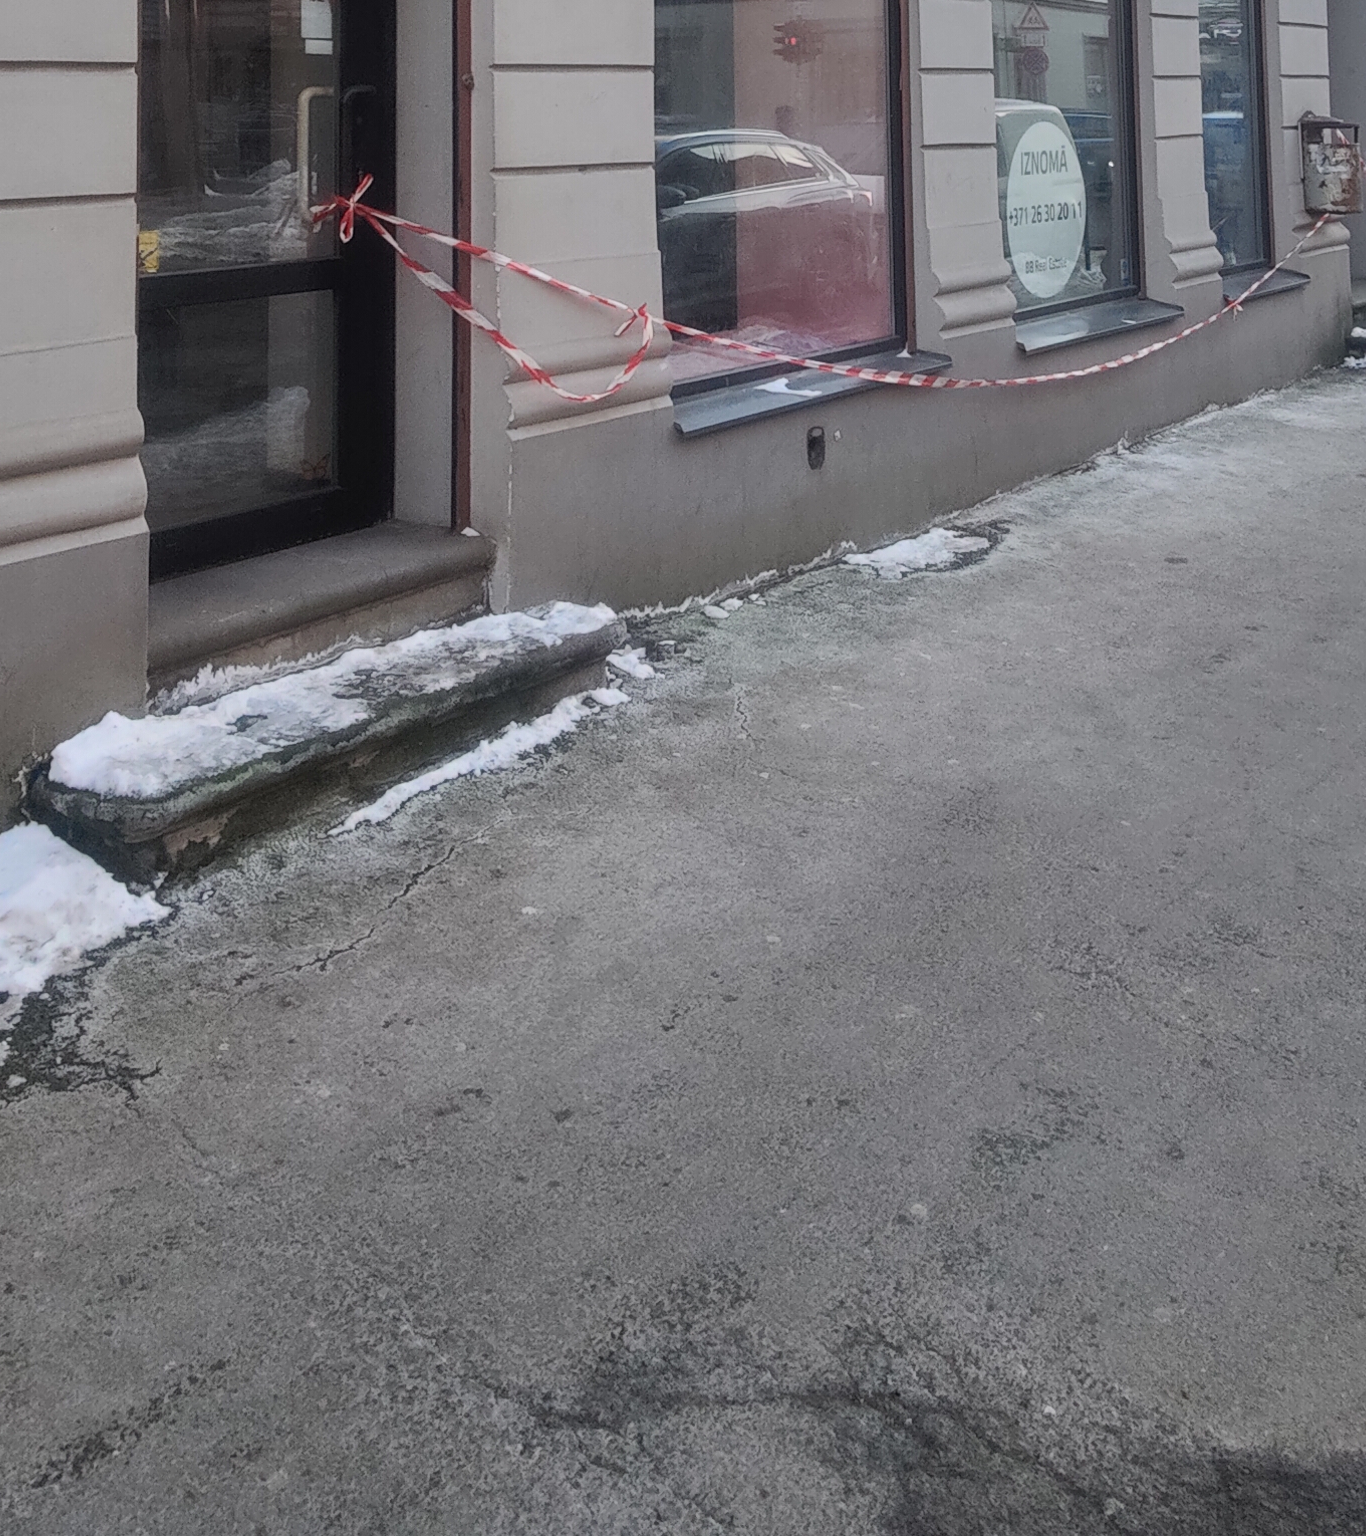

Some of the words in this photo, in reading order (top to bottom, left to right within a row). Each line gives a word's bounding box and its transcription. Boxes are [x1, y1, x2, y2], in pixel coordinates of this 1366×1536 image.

[1020, 144, 1069, 176] IZNOMĀ
[1008, 207, 1029, 227] +371
[1031, 204, 1043, 224] 26
[1044, 203, 1055, 222] 30
[1057, 202, 1069, 221] 20
